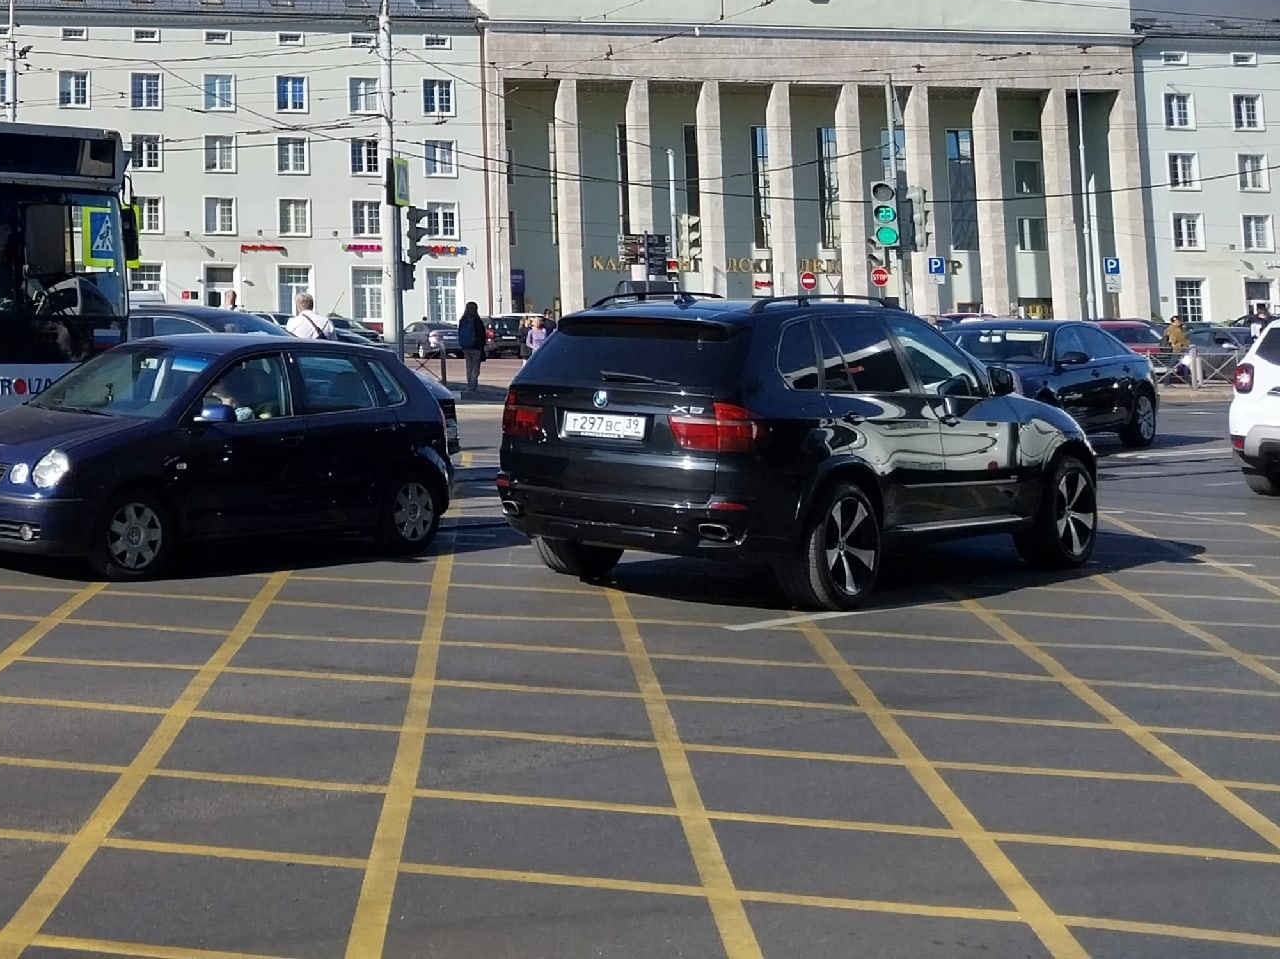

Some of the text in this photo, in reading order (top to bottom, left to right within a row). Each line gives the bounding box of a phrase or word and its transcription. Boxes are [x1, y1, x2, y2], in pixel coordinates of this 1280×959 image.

[879, 208, 893, 221] 23
[931, 259, 941, 272] P
[1107, 260, 1117, 272] P
[670, 405, 705, 414] X5
